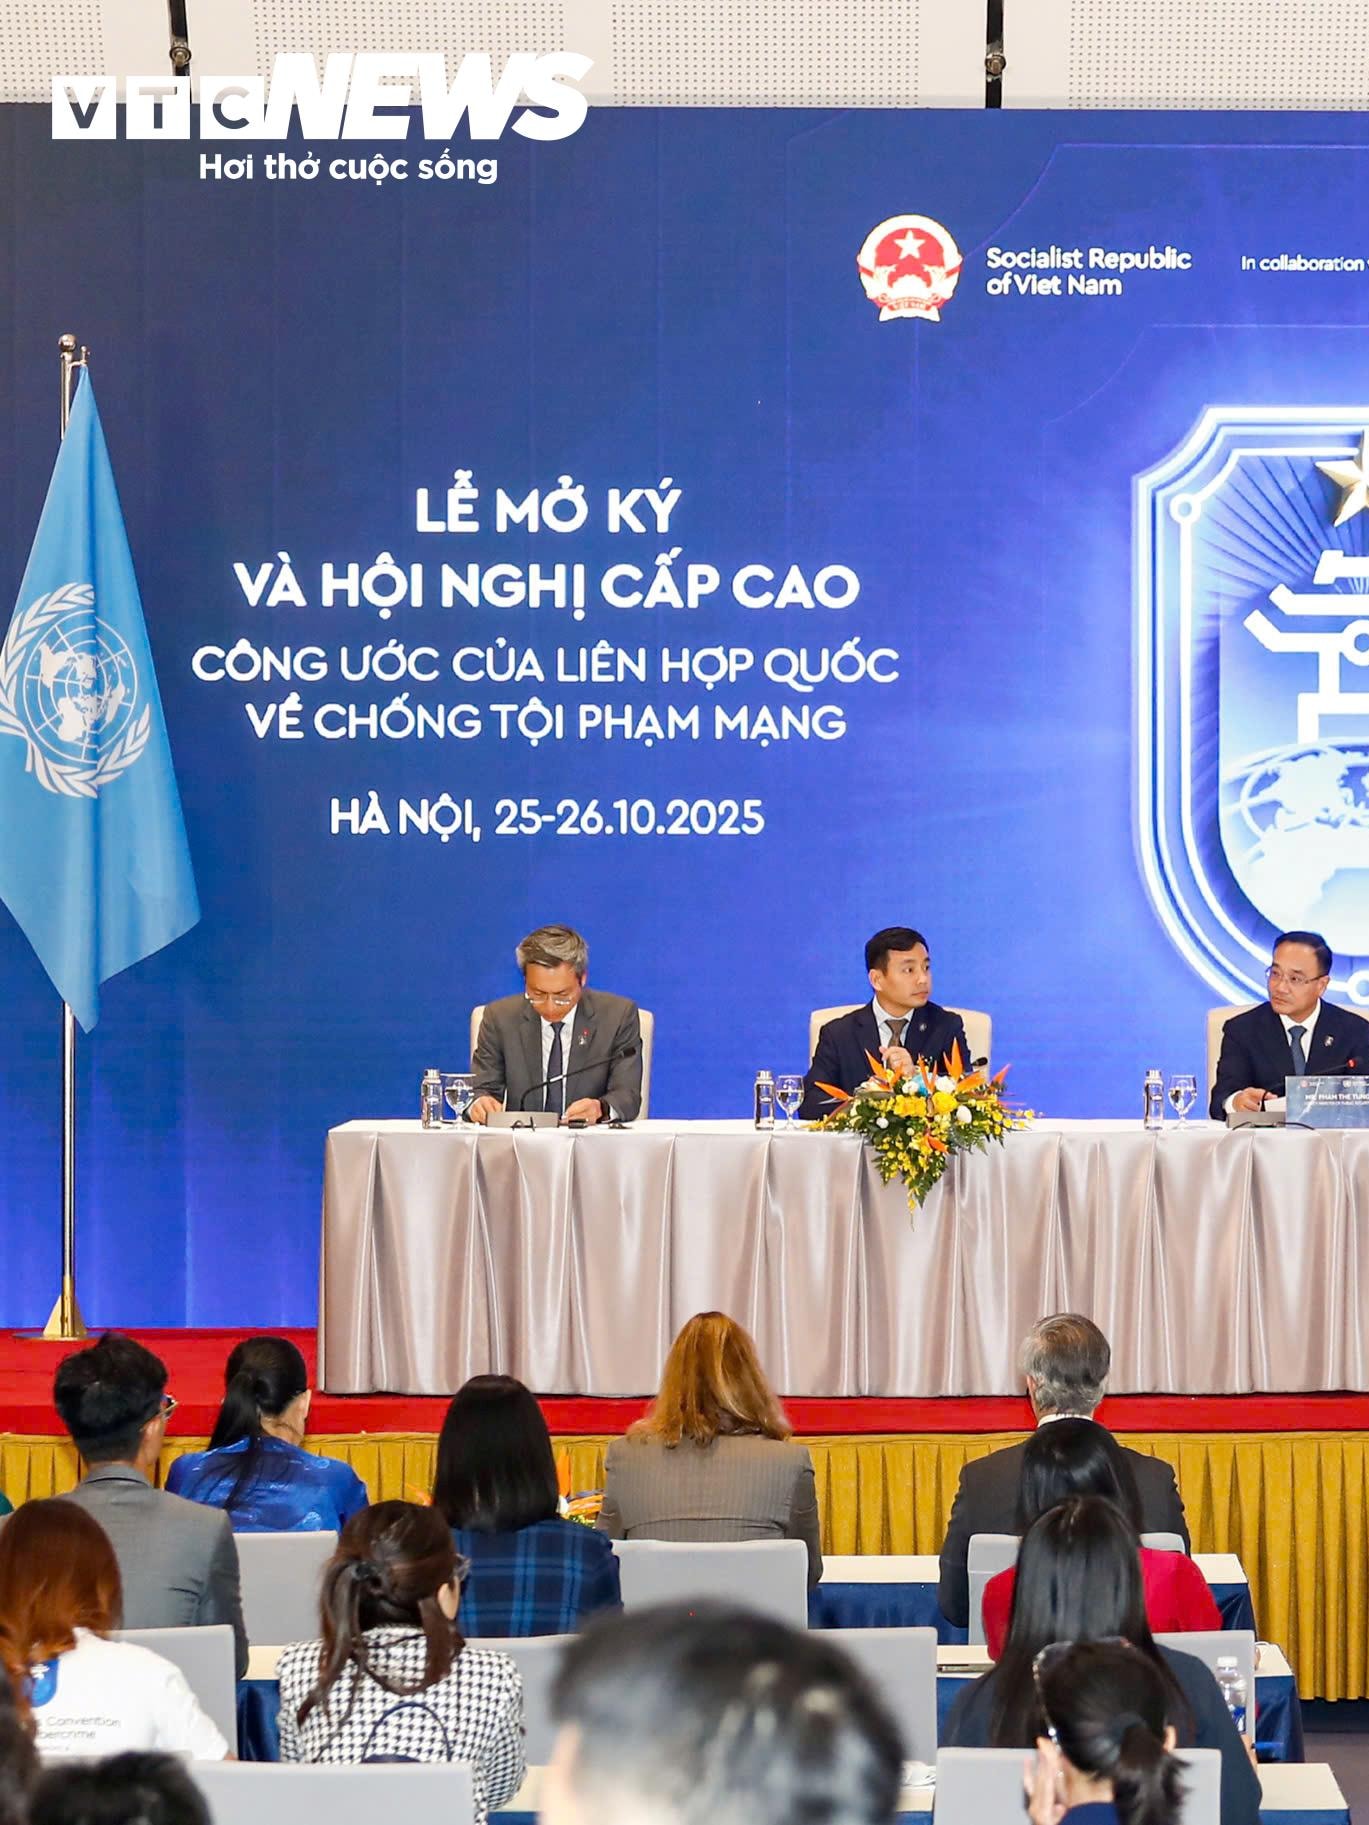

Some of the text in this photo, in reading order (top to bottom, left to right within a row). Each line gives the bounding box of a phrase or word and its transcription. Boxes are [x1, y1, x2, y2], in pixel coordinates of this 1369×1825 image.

[986, 245, 1192, 273] Socialist Republic
[986, 271, 1123, 296] of Viet Nam
[1241, 255, 1256, 271] In
[1259, 254, 1365, 272] collaboration
[416, 469, 682, 533] LỄ MỞ KÝ
[233, 547, 860, 621] VÀ HỘI NGHỊ CẤP CAO
[192, 637, 899, 693] CÔNG ƯỚC CỦA LIÊN HỢP QUỐC
[314, 692, 482, 739] CHỐNG
[490, 696, 563, 747] TỘI
[579, 704, 699, 747] PHẠM
[715, 705, 846, 747] MẠNG
[331, 790, 765, 843] HÀ NỘI, 25-26.10.2025
